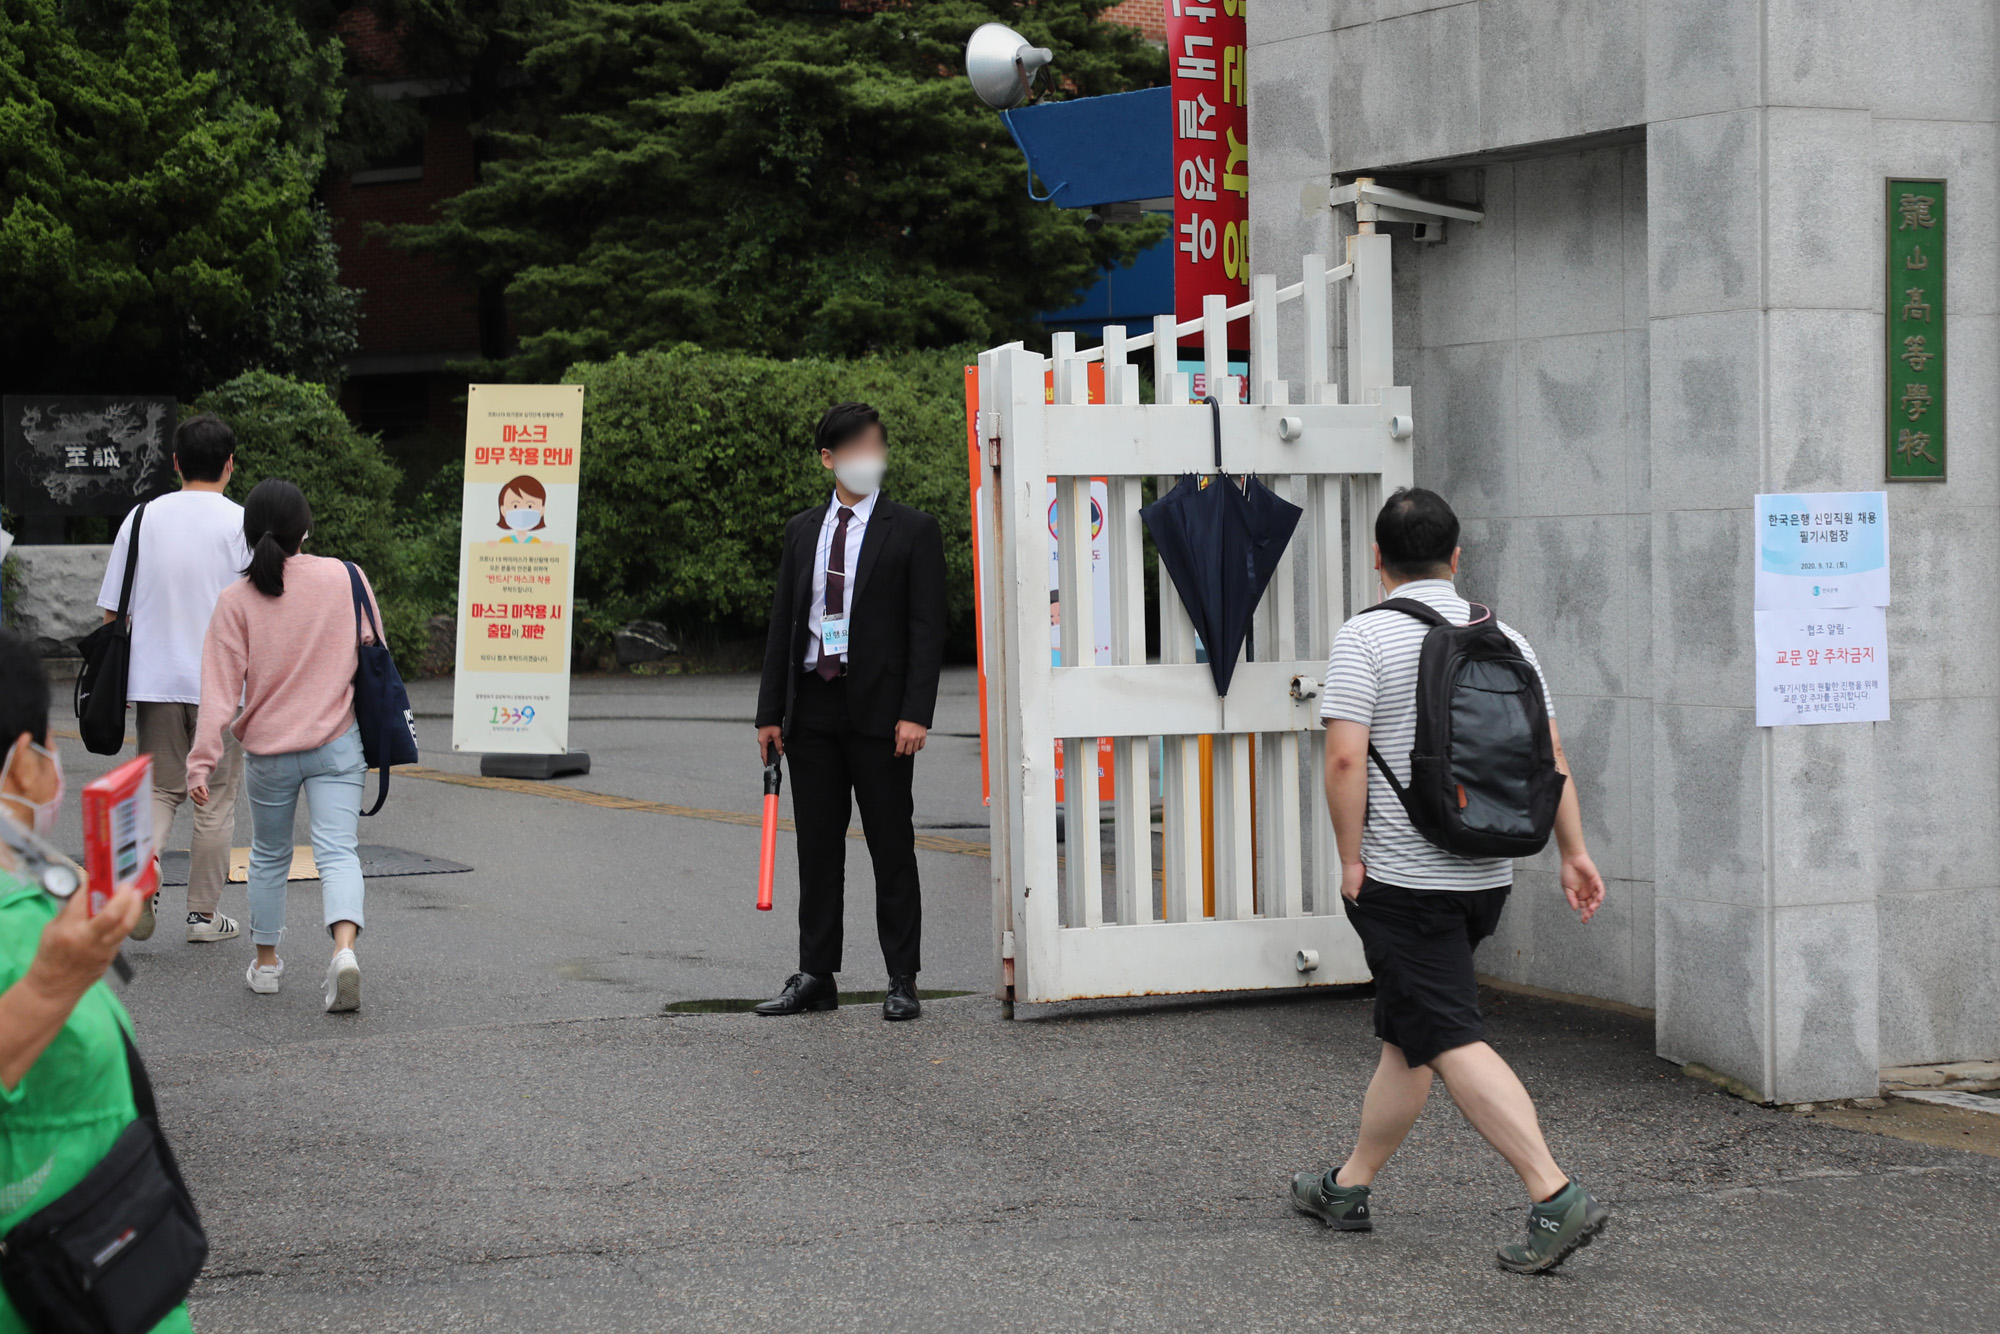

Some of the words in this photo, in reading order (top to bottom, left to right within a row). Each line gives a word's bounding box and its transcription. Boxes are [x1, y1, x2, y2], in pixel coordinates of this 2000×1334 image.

[503, 425, 547, 443] 마스크
[65, 445, 121, 468] 至誠
[475, 447, 505, 465] 의무
[509, 447, 539, 466] 착용
[543, 448, 573, 466] 안내
[1768, 513, 1810, 527] 한국은행
[1814, 512, 1853, 526] 신입직원
[1857, 511, 1877, 525] 채용
[1799, 530, 1849, 544] 필기시험장
[1801, 562, 1816, 570] 2020.
[1836, 561, 1848, 569] (토)
[514, 575, 535, 584] 마스크
[537, 575, 551, 585] 착용
[471, 603, 508, 619] 마스크
[512, 604, 547, 619] 미착용
[550, 604, 561, 619] 시
[488, 624, 519, 639] 출입이
[521, 624, 545, 640] 제한
[1807, 624, 1825, 636] 협조
[1827, 624, 1845, 635] 알림
[1775, 650, 1802, 666] 교문
[1806, 649, 1819, 666] 앞
[1824, 647, 1874, 664] 주차금지
[1817, 682, 1839, 692] 원활한
[1841, 681, 1862, 691] 진행을
[1864, 680, 1879, 690] 위해
[1783, 694, 1798, 704] 교문
[1800, 694, 1807, 704] 앞
[1810, 693, 1830, 703] 주차를
[1833, 691, 1870, 701] 금지합니다.
[489, 705, 535, 725] 1339
[1796, 704, 1811, 714] 협조
[1813, 702, 1858, 713] 부탁드립니다.
